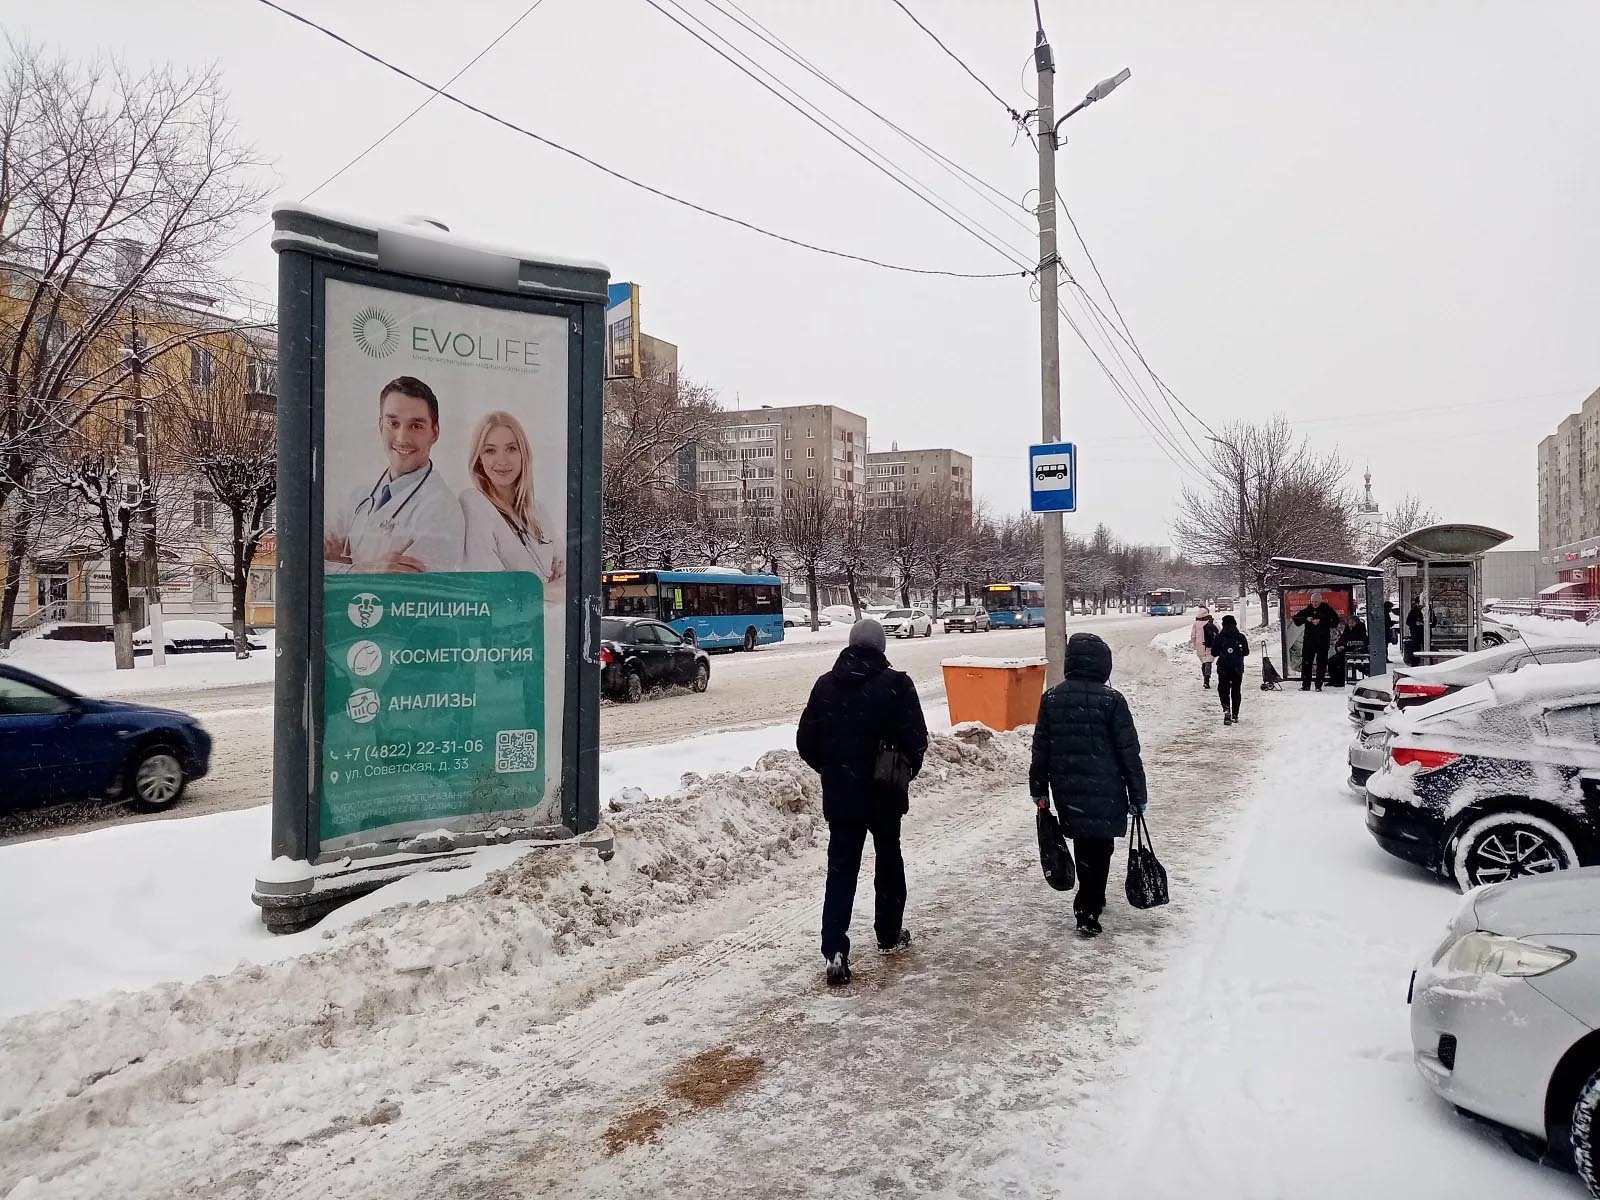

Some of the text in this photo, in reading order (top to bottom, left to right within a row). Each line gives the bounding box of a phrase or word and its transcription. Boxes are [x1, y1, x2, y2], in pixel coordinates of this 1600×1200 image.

[412, 326, 541, 366] EVOLIFE
[391, 602, 491, 619] МЕДИЦИНА
[389, 647, 534, 665] КОСМЕТОЛОГИЯ
[388, 693, 477, 711] АНАЛИЗЫ
[344, 739, 484, 762] +7 (4822) 22-31-06
[344, 757, 469, 784] ул. Советская, д. 33
